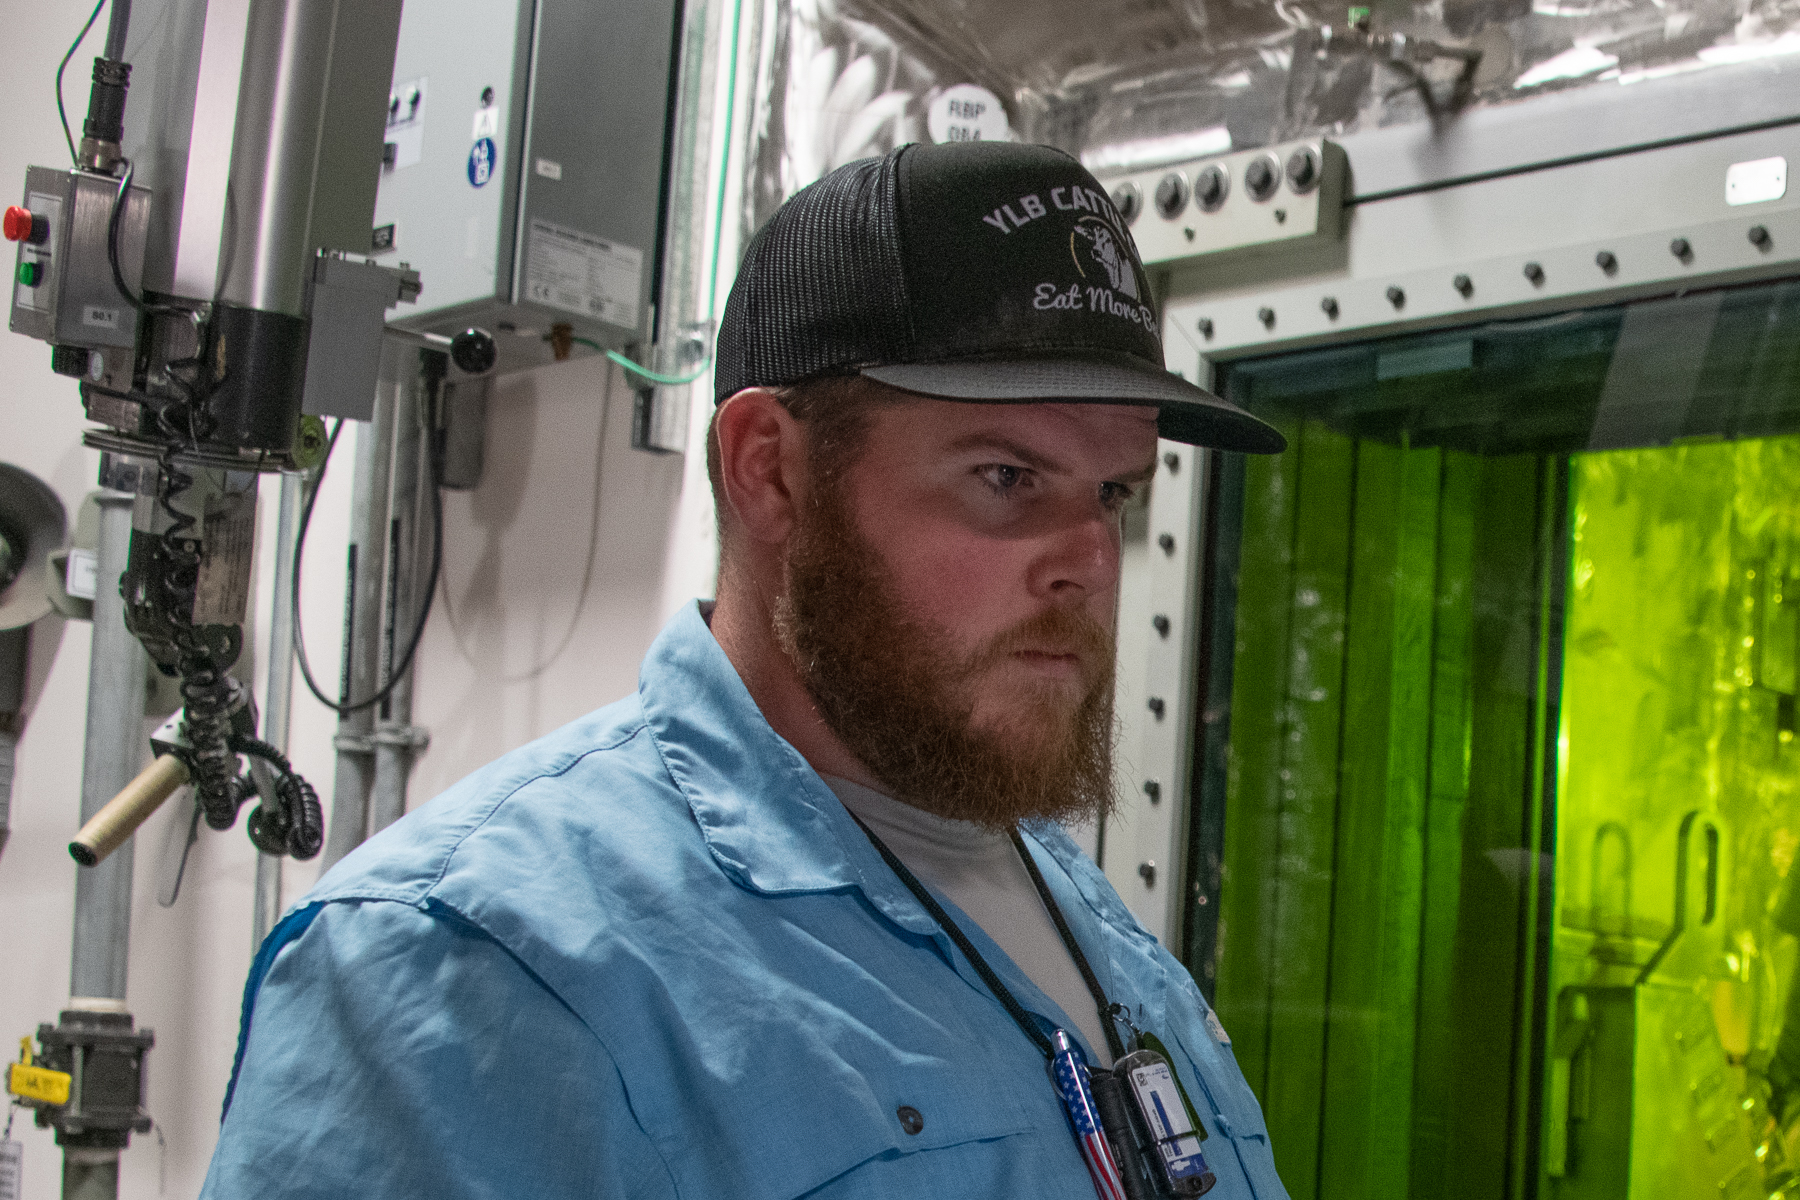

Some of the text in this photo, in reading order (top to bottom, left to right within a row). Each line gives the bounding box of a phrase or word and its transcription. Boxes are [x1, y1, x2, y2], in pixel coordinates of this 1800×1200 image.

[949, 100, 986, 120] RBP
[982, 194, 1047, 235] YLB
[1033, 282, 1083, 310] Eat
[1086, 286, 1142, 324] More
